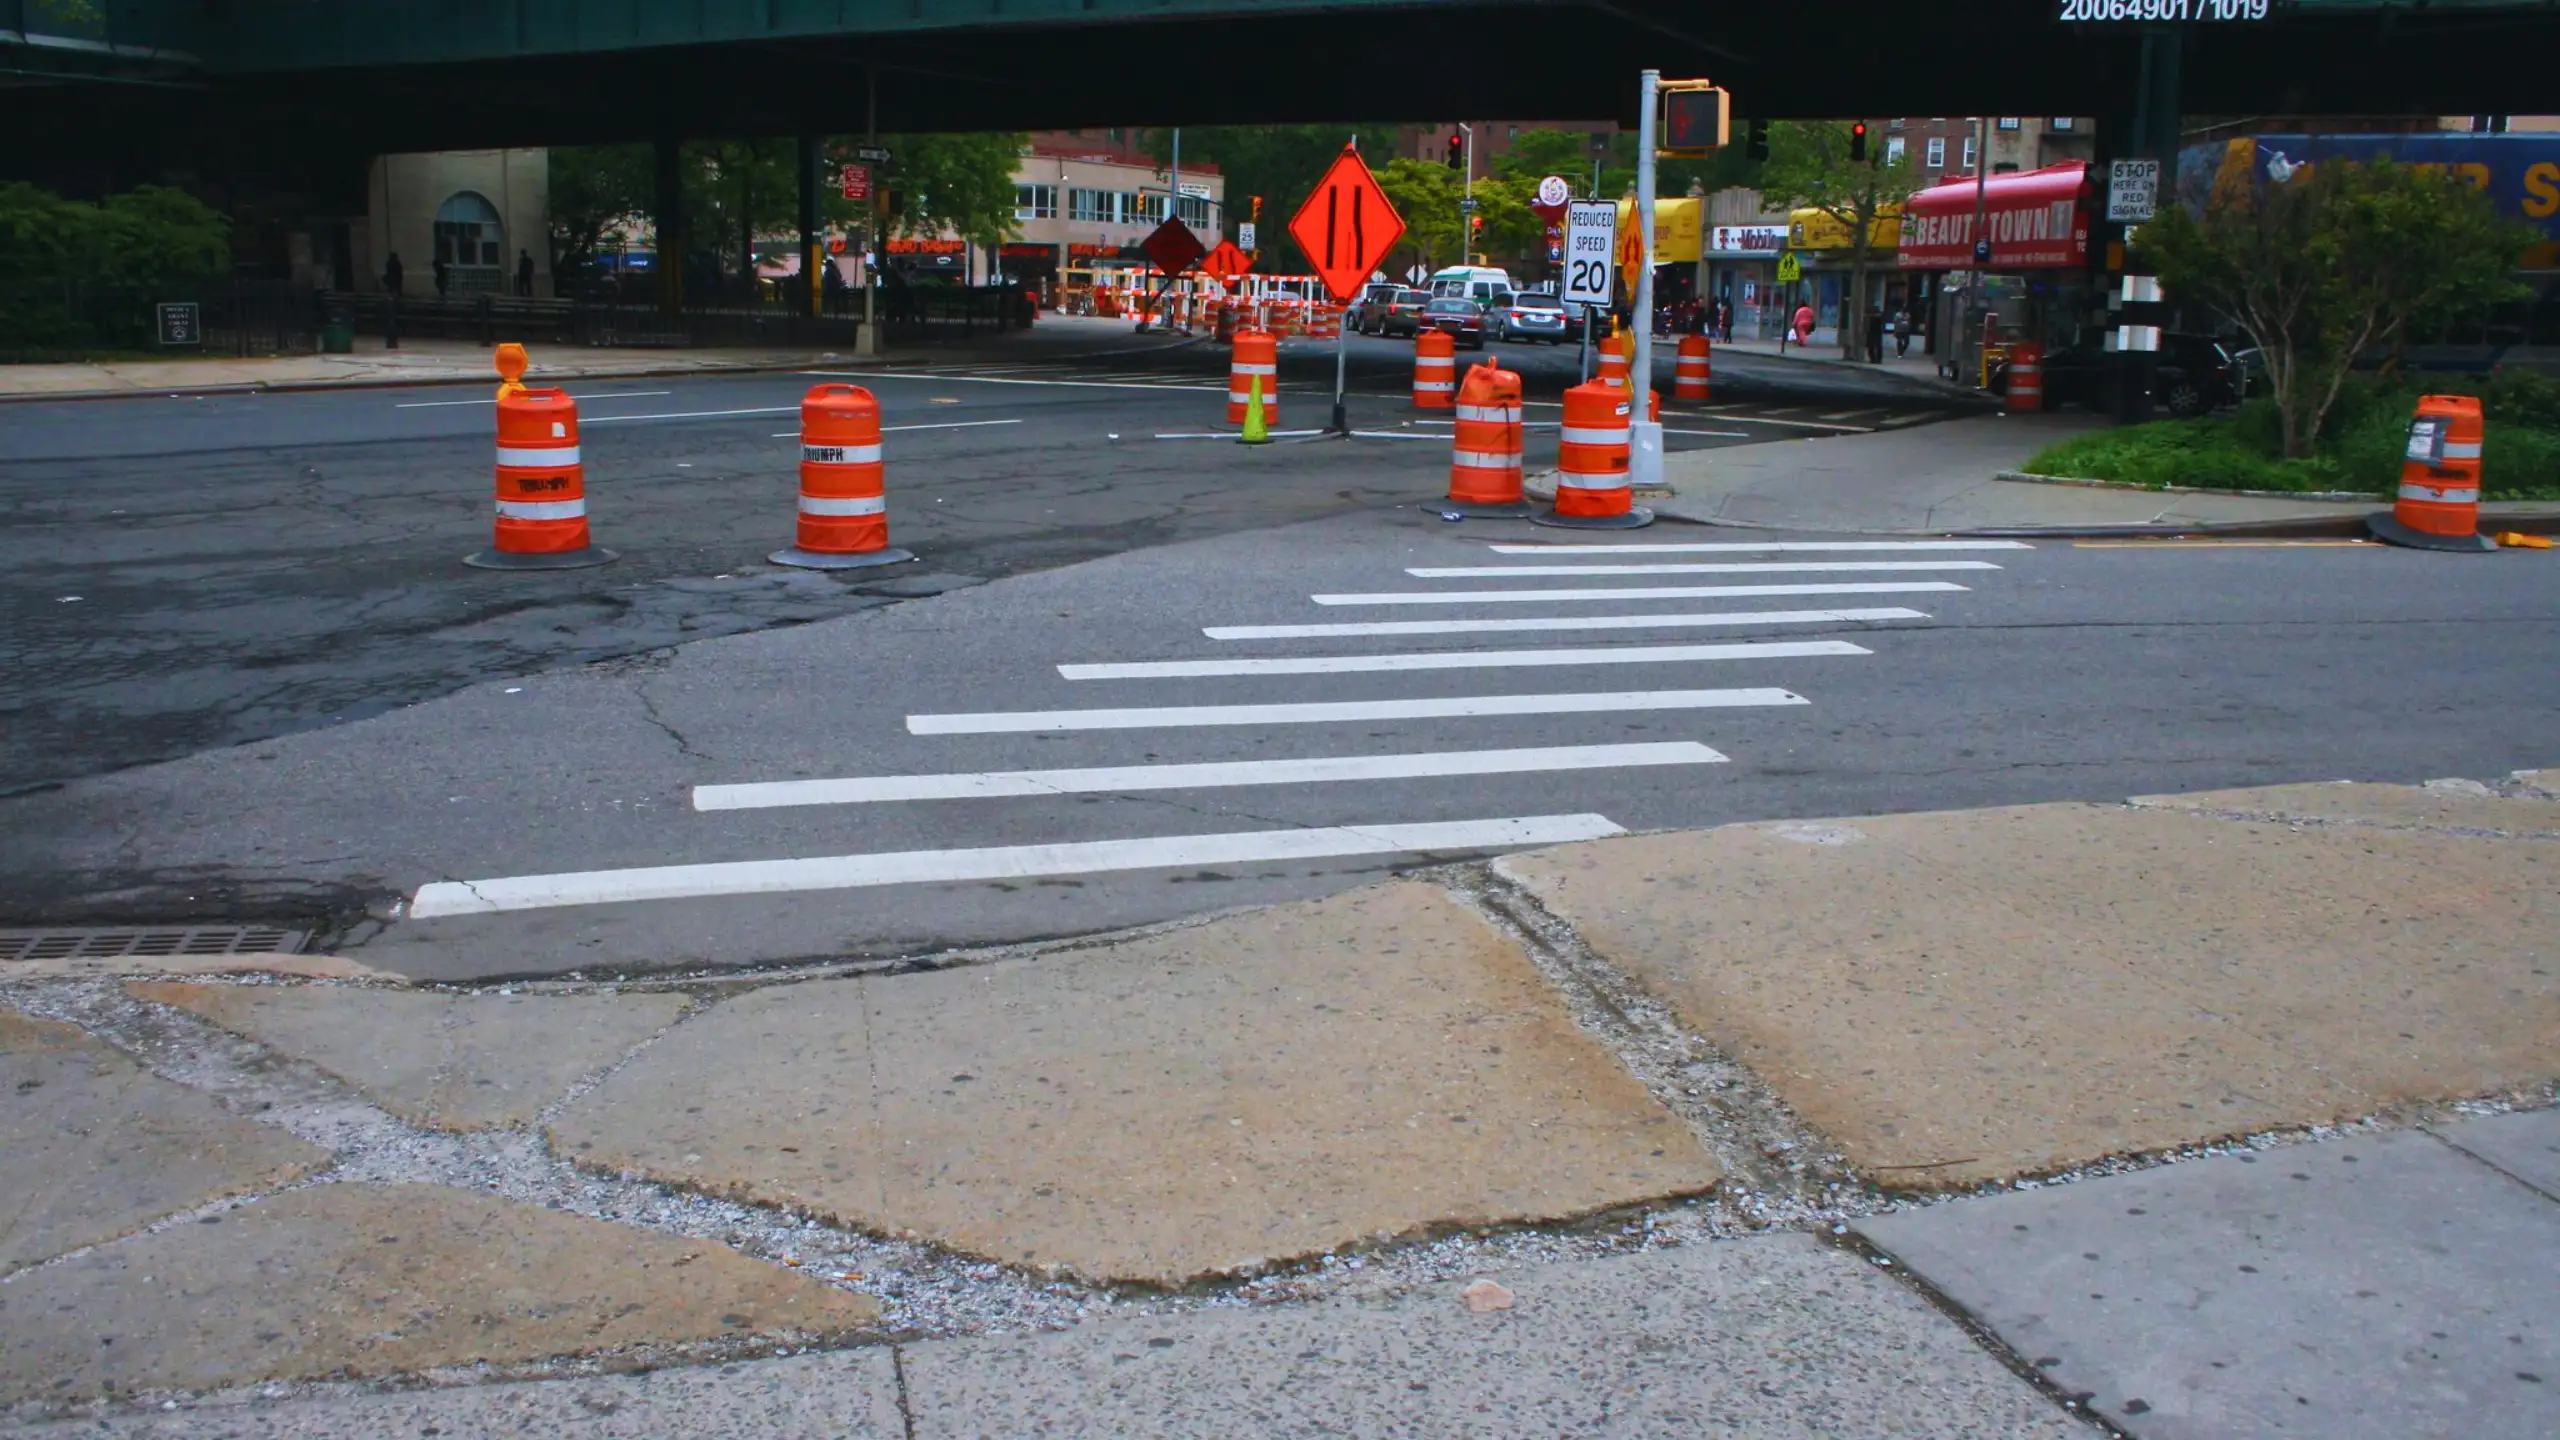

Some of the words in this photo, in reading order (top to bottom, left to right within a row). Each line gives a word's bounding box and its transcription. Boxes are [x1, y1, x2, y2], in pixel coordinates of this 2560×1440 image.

[2114, 163, 2157, 177] STOP
[2113, 180, 2137, 191] HERE
[2122, 192, 2144, 202] RED
[2112, 205, 2153, 216] SIGNAL
[1571, 211, 1613, 227] REDUCED
[1990, 207, 2050, 243] TOWN
[1242, 233, 1253, 242] 25
[1576, 236, 1606, 251] SPEED
[1571, 260, 1606, 295] 20
[804, 447, 844, 461] TRIUMPH
